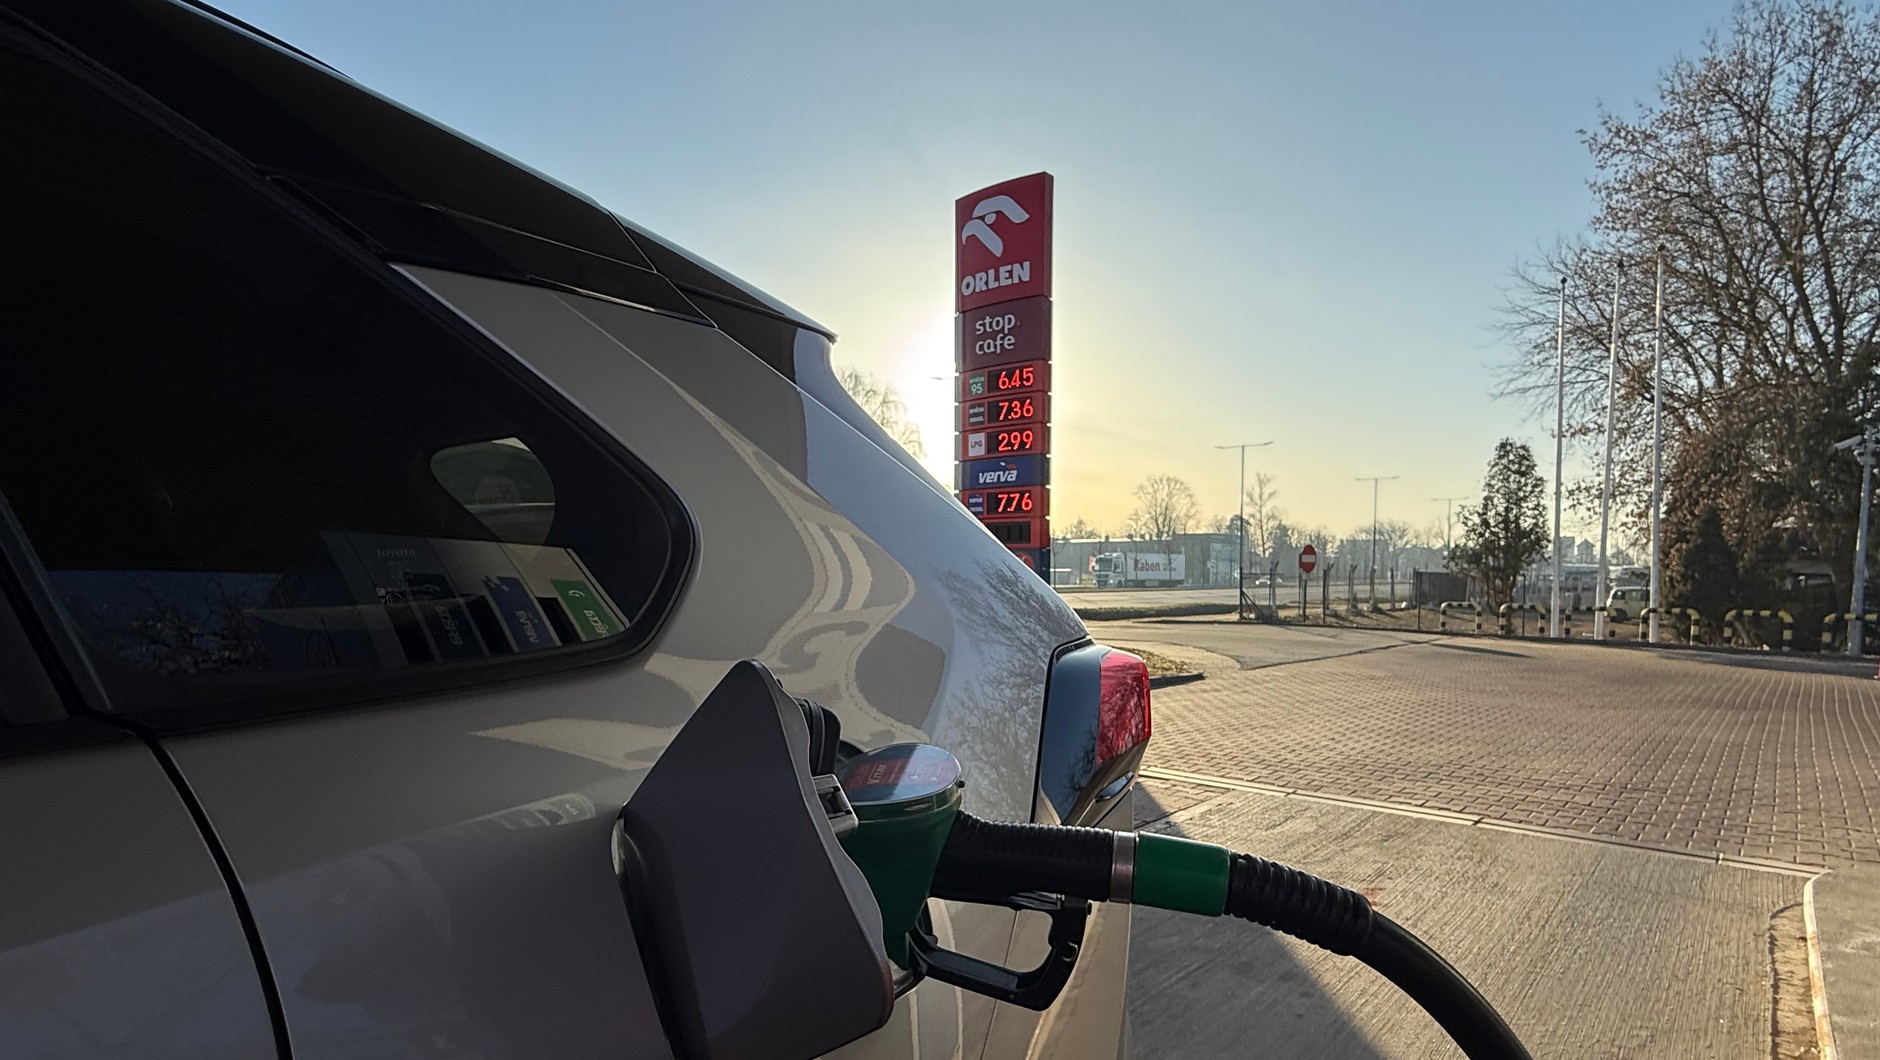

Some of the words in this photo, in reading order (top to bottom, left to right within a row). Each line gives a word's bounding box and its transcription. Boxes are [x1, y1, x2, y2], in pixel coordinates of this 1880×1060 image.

[961, 261, 1031, 296] ORLEN
[975, 313, 1016, 335] stop
[975, 333, 1016, 355] cafe
[970, 382, 983, 395] 95
[998, 367, 1034, 390] 6.45
[998, 398, 1034, 421] 7.36
[970, 440, 983, 449] LPG
[998, 430, 1034, 452] 2.99
[978, 469, 1018, 484] verva
[997, 492, 1033, 513] 7.76
